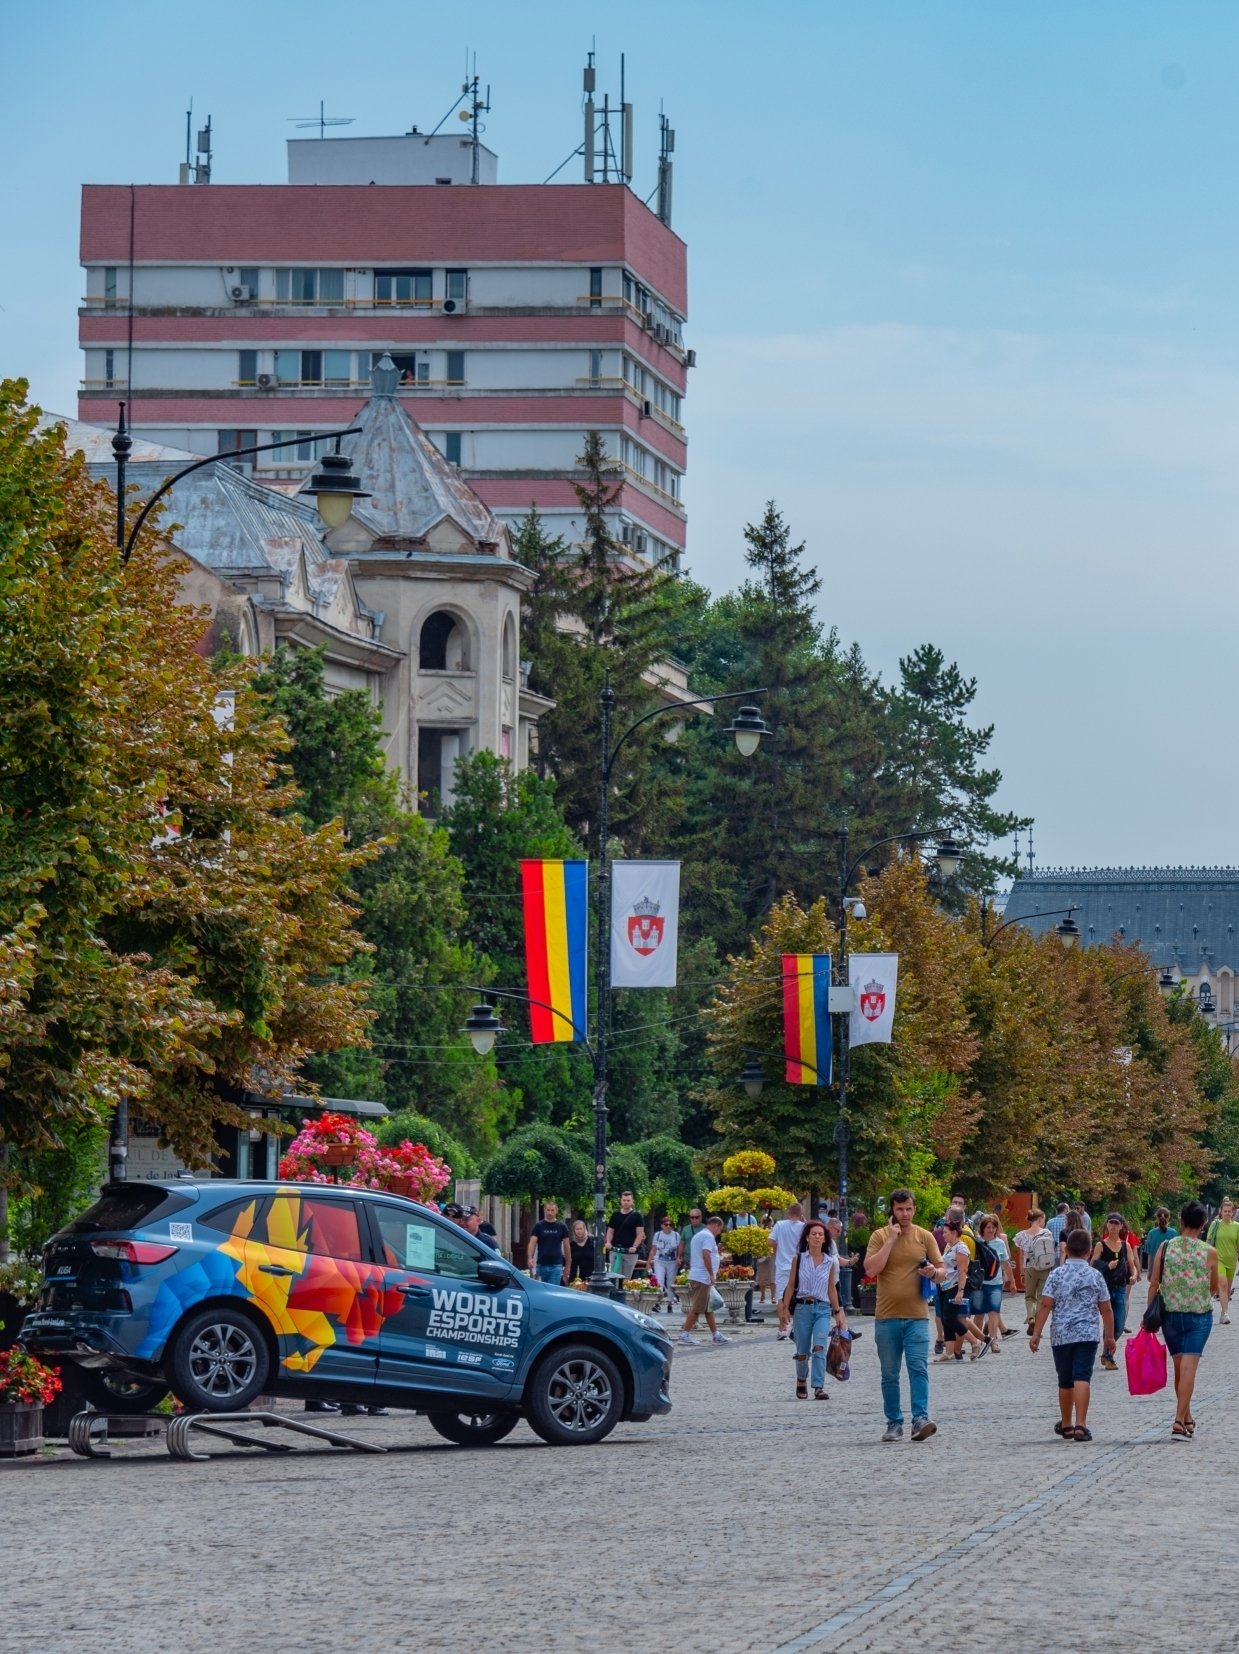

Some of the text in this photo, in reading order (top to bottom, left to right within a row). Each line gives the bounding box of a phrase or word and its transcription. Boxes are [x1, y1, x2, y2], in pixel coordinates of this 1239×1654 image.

[57, 1266, 72, 1275] KUGA
[431, 1288, 524, 1320] WORLD
[428, 1309, 521, 1337] ESPORTS
[426, 1326, 519, 1348] CHAMPIONSHIPS
